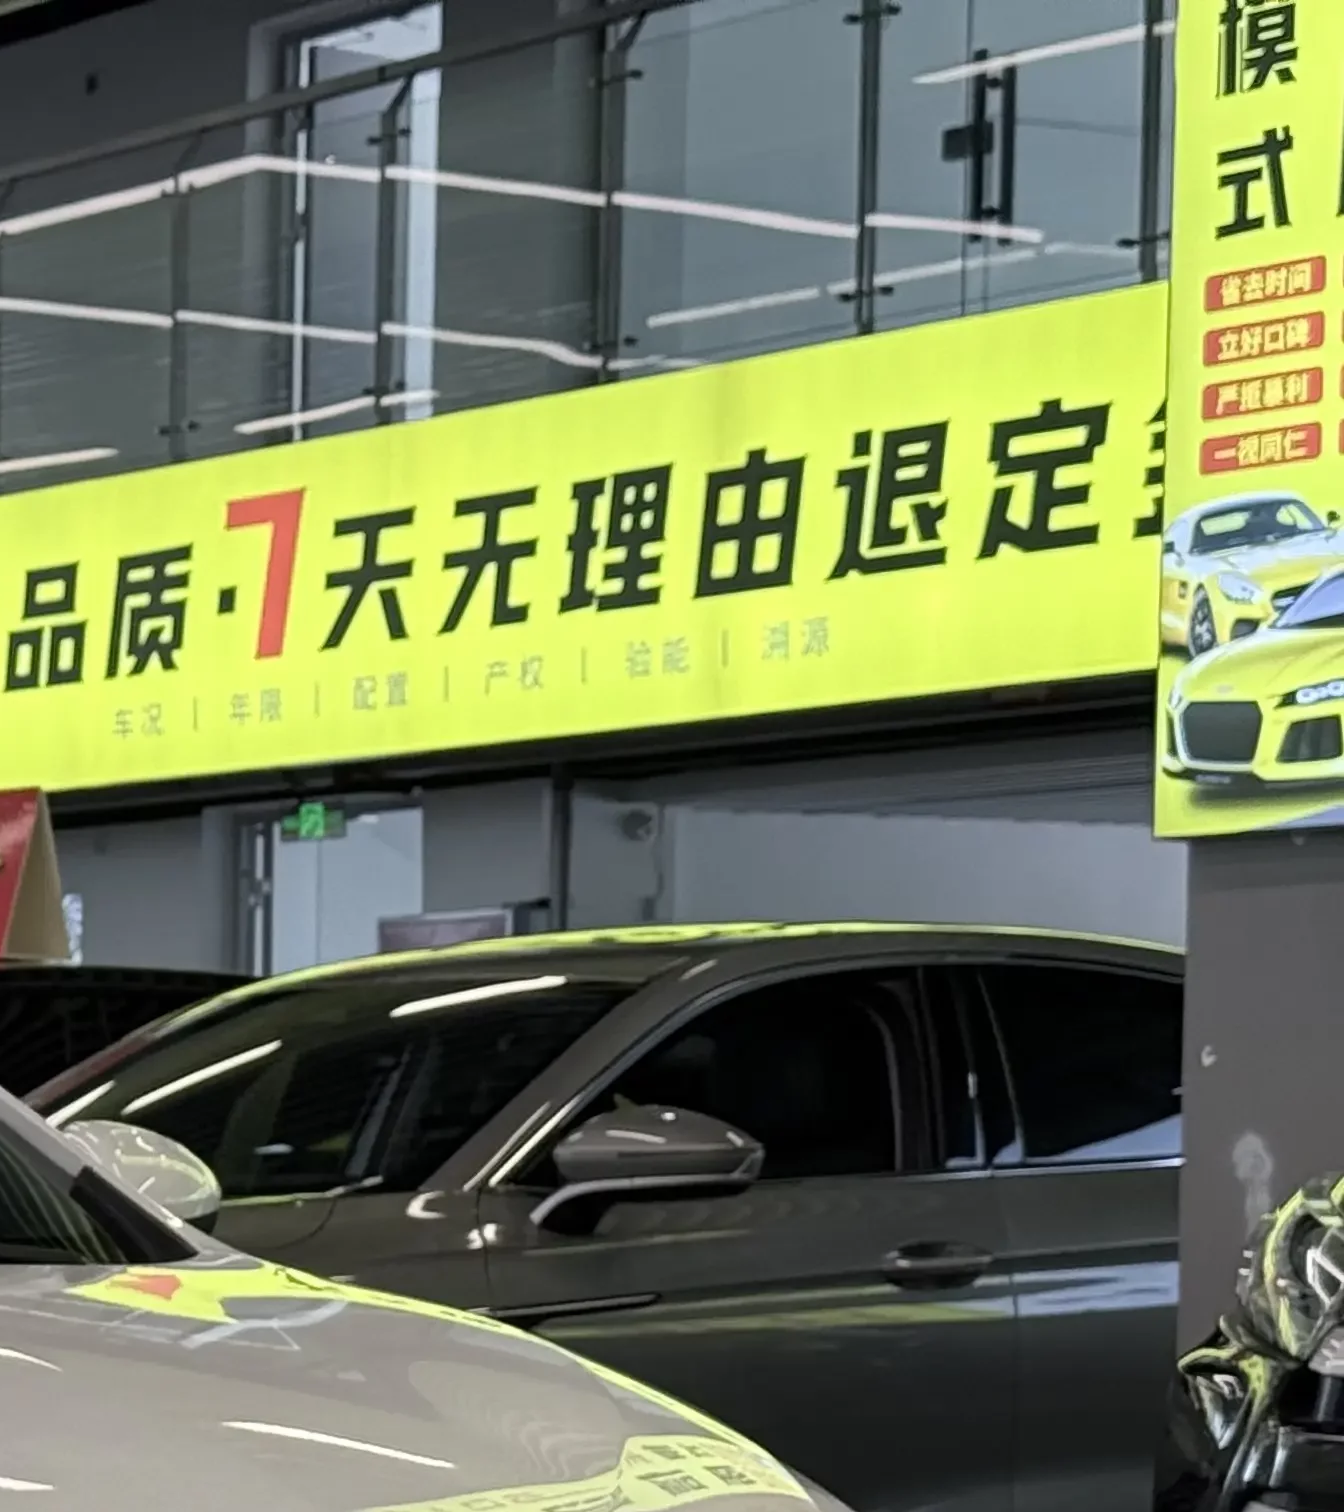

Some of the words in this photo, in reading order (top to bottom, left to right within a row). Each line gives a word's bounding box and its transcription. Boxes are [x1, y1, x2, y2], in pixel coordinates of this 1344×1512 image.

[1215, 0, 1299, 240] 模式
[1213, 428, 1308, 467] 一视同仁
